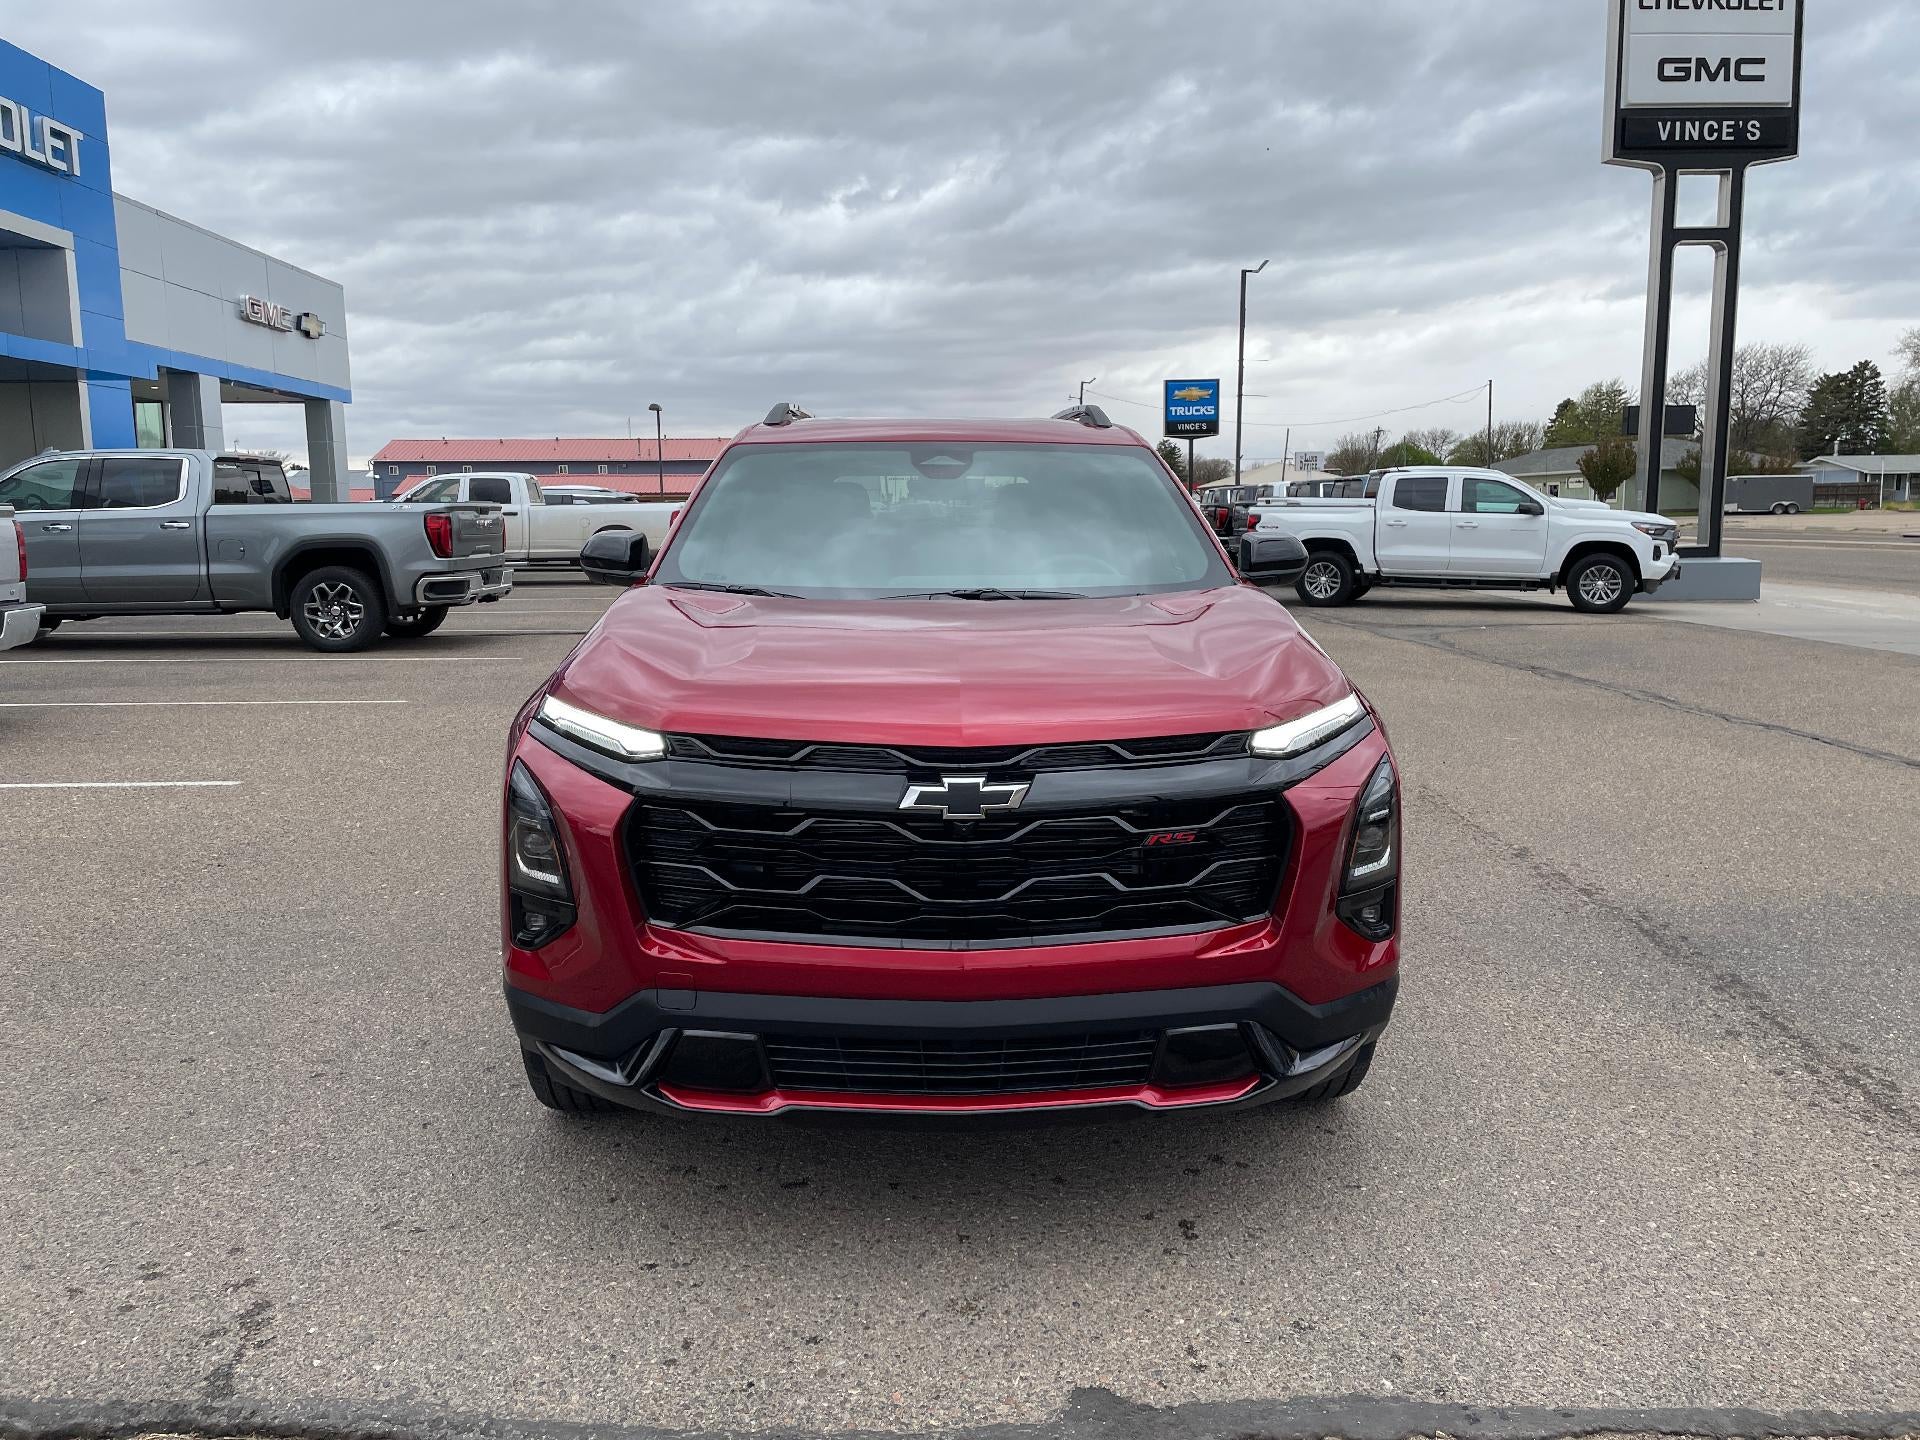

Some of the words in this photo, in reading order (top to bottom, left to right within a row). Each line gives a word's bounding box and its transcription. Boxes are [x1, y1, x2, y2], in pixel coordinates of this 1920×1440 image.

[1657, 57, 1766, 82] GMC
[1657, 120, 1761, 141] VINCE'S
[242, 294, 294, 332] GMC
[1169, 405, 1215, 416] TRUCKS
[1177, 422, 1207, 431] VINCE'S
[1143, 832, 1197, 846] RS
